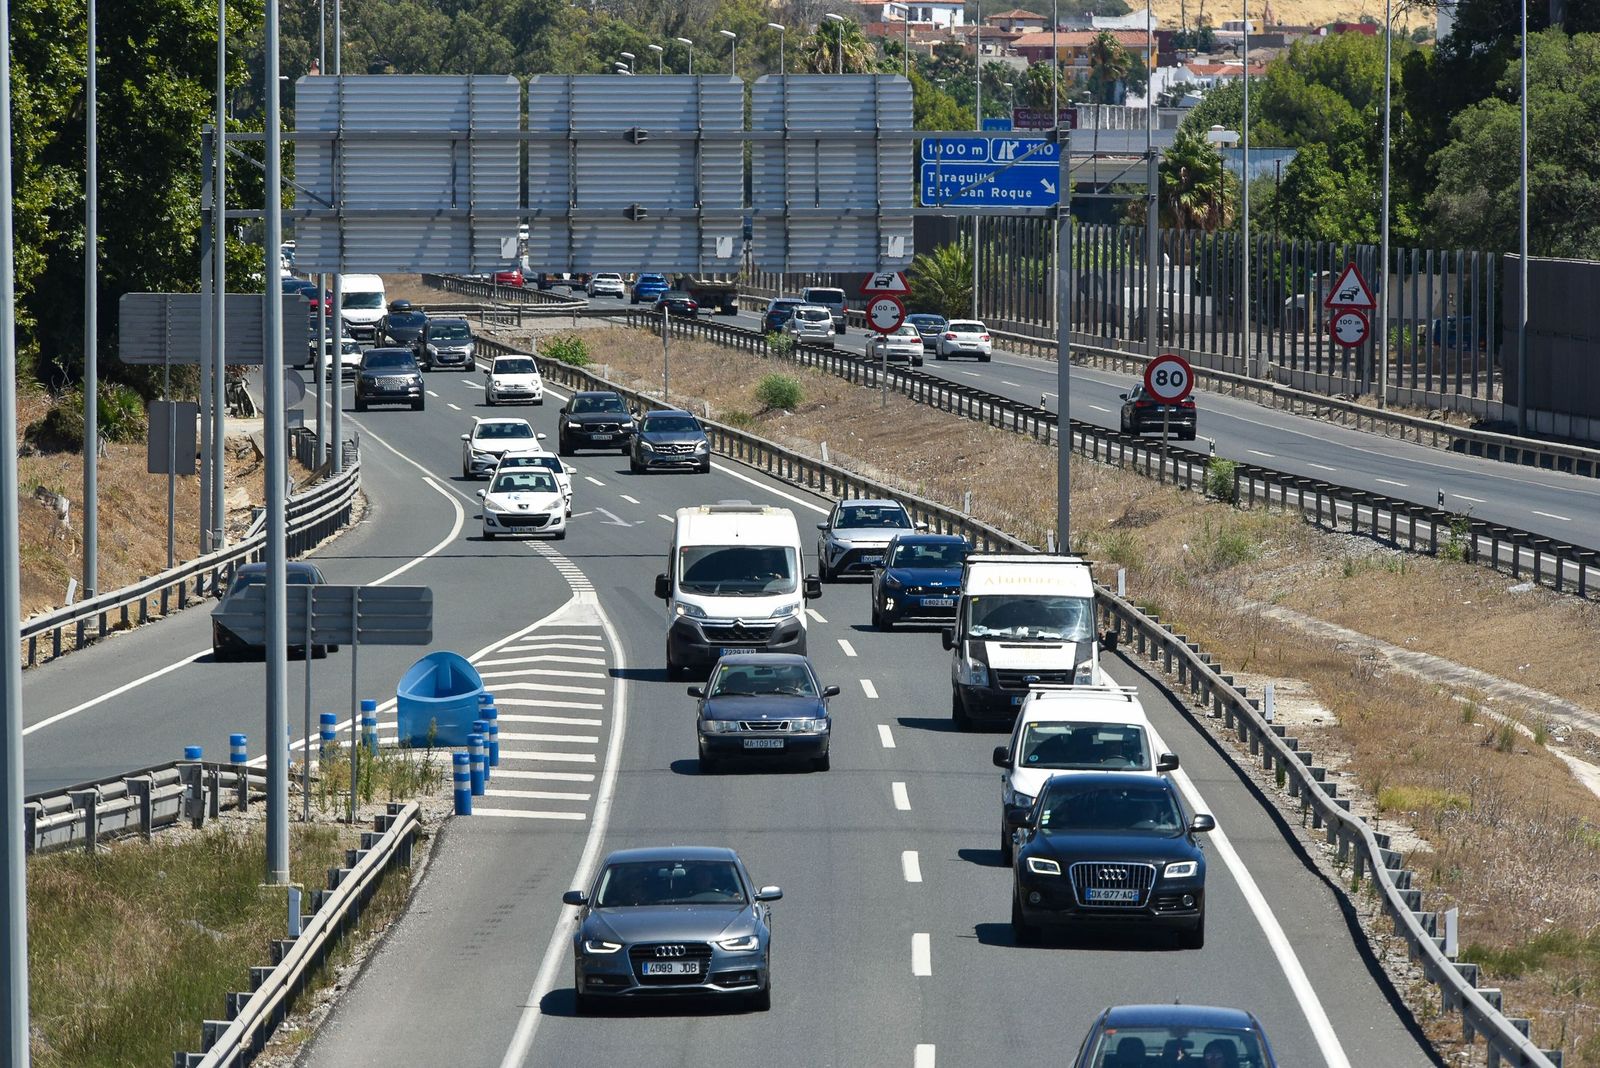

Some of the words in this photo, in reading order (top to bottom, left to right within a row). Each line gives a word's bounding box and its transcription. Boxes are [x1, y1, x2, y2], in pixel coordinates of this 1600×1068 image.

[928, 144, 966, 155] 1000
[971, 146, 983, 155] m
[927, 187, 953, 197] Est.
[960, 187, 984, 197] San
[991, 187, 1033, 199] Roque
[1155, 369, 1184, 387] 80
